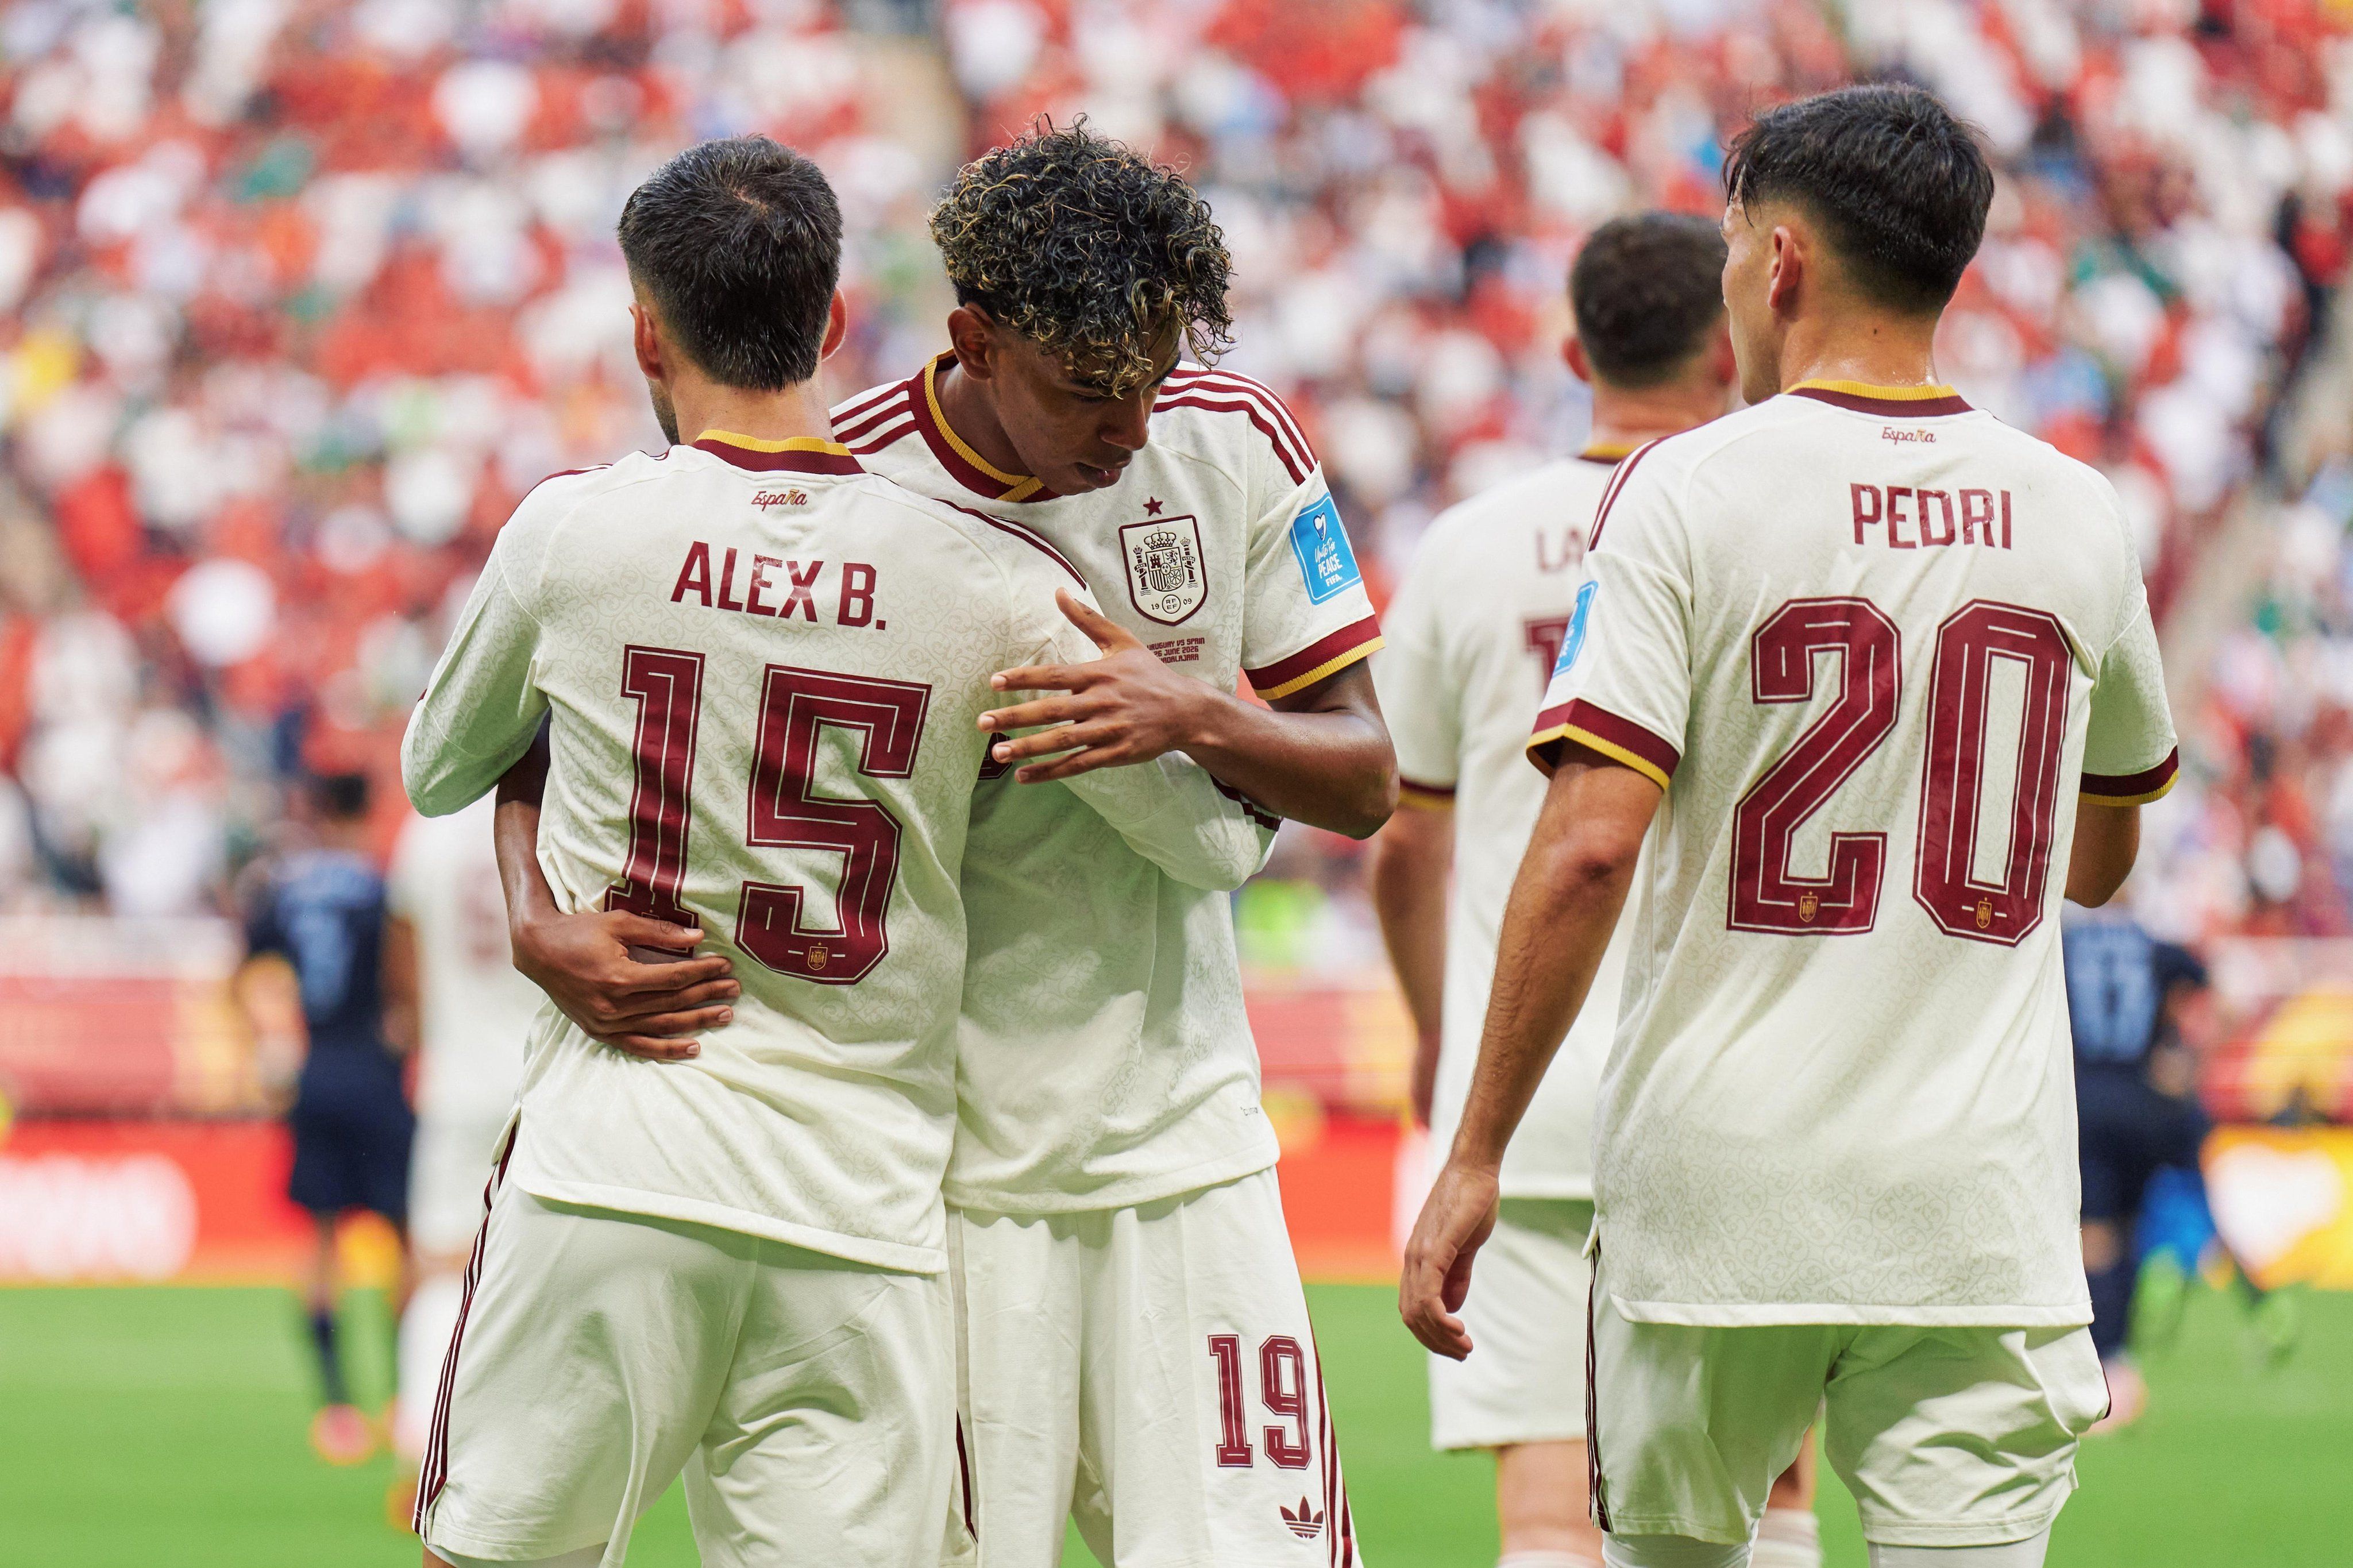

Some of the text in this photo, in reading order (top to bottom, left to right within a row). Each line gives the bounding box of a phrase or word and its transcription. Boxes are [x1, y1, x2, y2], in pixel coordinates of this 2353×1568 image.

[1882, 426, 1936, 445] España
[751, 489, 807, 511] España
[1850, 482, 2012, 550] PEDRI
[1315, 537, 1336, 563] Unite For
[1318, 553, 1343, 579] PEACE
[670, 540, 886, 631] ALEX B.
[1325, 573, 1343, 586] FIFA
[1147, 640, 1175, 650] URUGUAY
[1164, 647, 1180, 656] JUNE
[1182, 646, 1199, 654] 2026
[1159, 654, 1199, 664] ADALAJARA
[1726, 596, 2075, 948] 20
[604, 644, 932, 986] 15
[1208, 1334, 1312, 1470] 19
